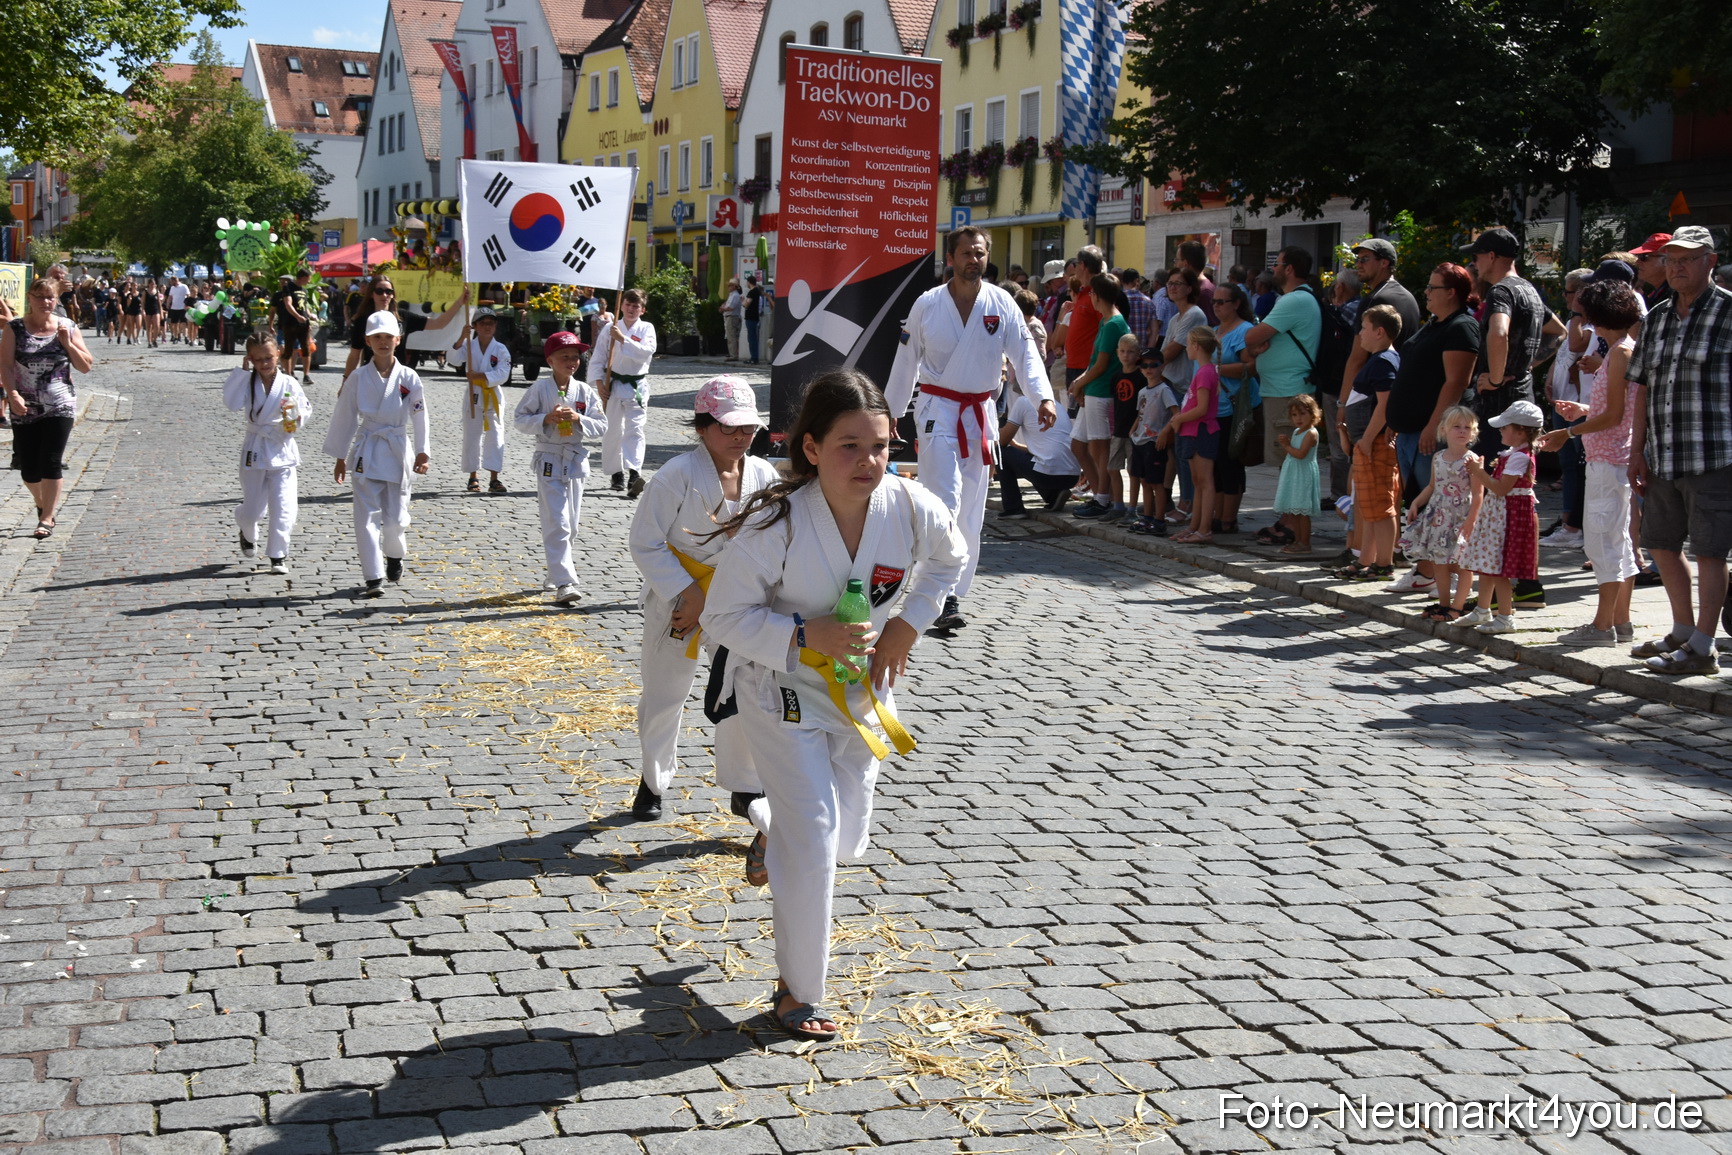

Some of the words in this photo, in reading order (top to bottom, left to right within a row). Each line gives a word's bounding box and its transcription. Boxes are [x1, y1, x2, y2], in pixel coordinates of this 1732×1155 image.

[496, 30, 513, 65] K&L
[795, 57, 934, 89] Traditionelles
[797, 81, 930, 112] Taekwon-Do
[818, 109, 844, 123] ASV
[846, 111, 907, 128] Neumarkt
[599, 130, 619, 149] HOTEL
[791, 137, 819, 148] Kunst
[821, 139, 839, 150] der
[840, 141, 931, 160] Selbstverteidigung
[790, 154, 850, 168] Koordination
[865, 160, 931, 174] Konzentration
[789, 170, 886, 189] Körperbeherrschung
[893, 178, 932, 192] Disziplin
[789, 187, 873, 203] Selbstbewusstsein
[892, 195, 929, 207] Respekt
[1111, 189, 1124, 200] KINO
[788, 204, 859, 218] Bescheidenheit
[879, 210, 928, 223] Höflichkeit
[955, 210, 967, 229] P
[786, 220, 879, 239] Selbstbeherrschung
[894, 228, 929, 240] Geduld
[786, 237, 848, 251] Willensstärke
[882, 244, 927, 256] Ausdauer
[785, 690, 797, 711] KWON
